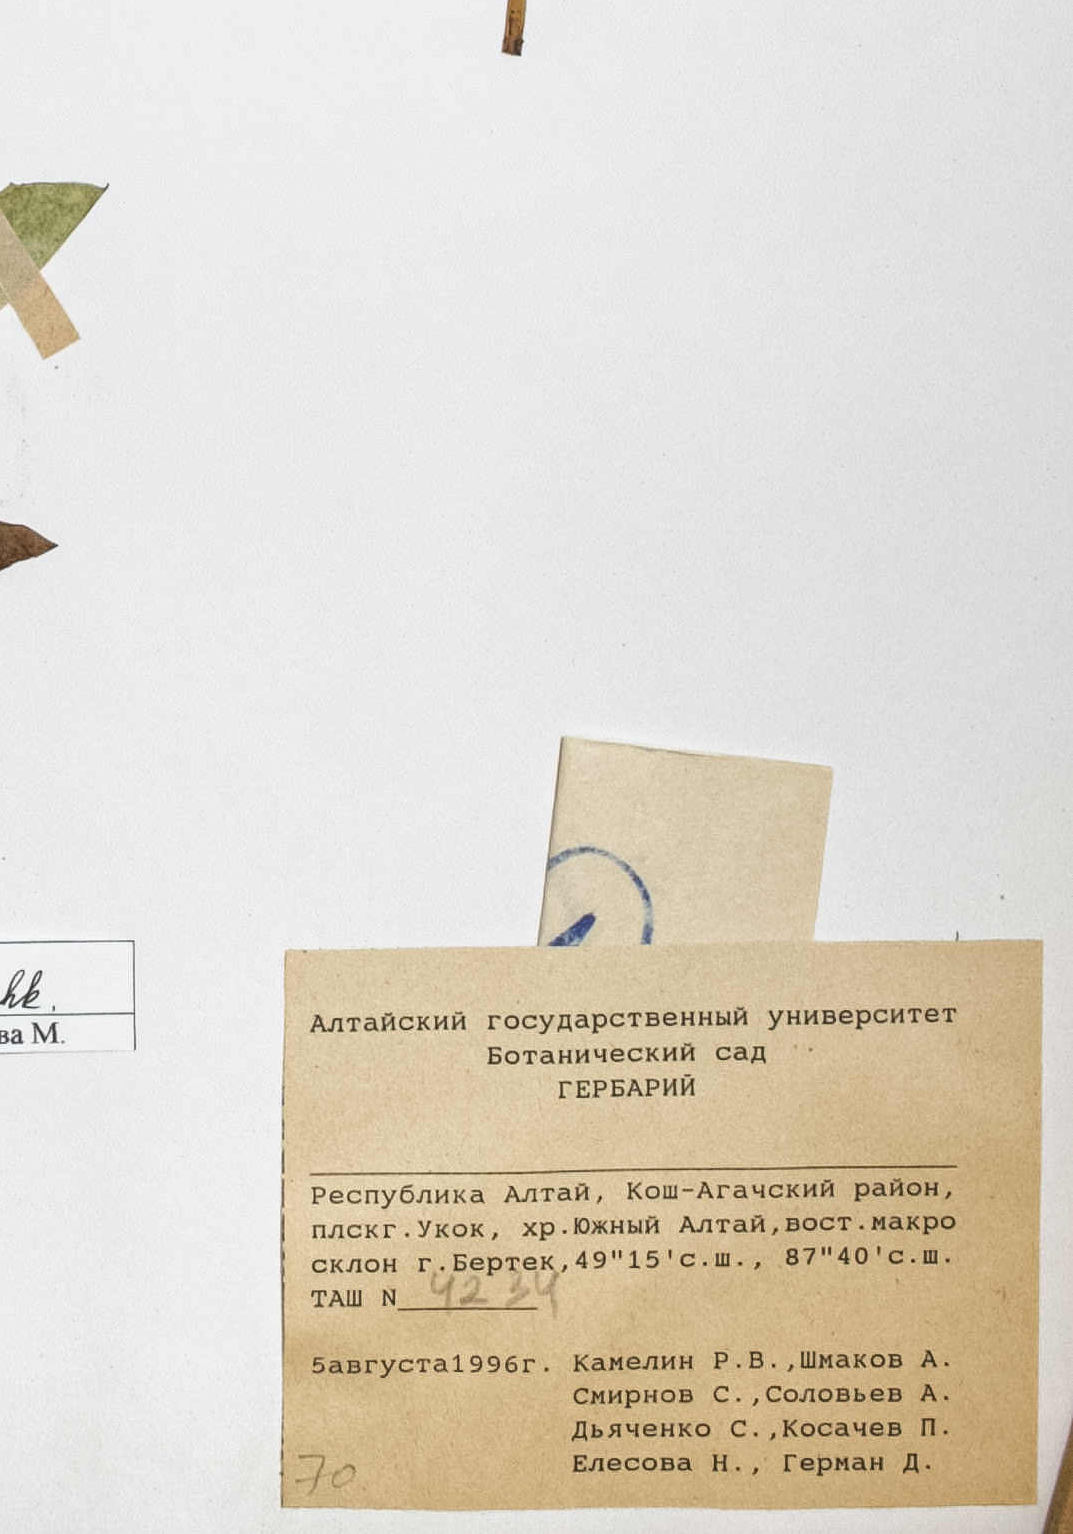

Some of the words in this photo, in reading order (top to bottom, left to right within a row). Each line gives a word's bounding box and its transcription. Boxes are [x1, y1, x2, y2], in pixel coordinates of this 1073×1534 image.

[310, 1011, 466, 1033] Алтайский
[488, 1006, 748, 1034] государственный
[767, 1008, 957, 1031] университет
[31, 1022, 66, 1046] М.
[487, 1042, 695, 1065] Ботанический
[716, 1046, 766, 1065] сад
[559, 1074, 695, 1099] ГЕРБАРИЙ
[311, 1184, 485, 1209] Республика
[504, 1183, 602, 1204] Алтай,
[627, 1179, 834, 1200] Кош-Агачский
[855, 1178, 951, 1202] район,
[312, 1258, 397, 1274] склон
[311, 1287, 363, 1308] ТАШ
[573, 1354, 693, 1372] Камелин
[921, 1350, 949, 1368] А.
[573, 1388, 693, 1408] Смирнов
[920, 1384, 948, 1402] А.
[571, 1421, 711, 1442] Дьяченко
[921, 1418, 948, 1436] П.
[573, 1455, 692, 1473] Елесова
[712, 1454, 758, 1475] Н.,
[783, 1454, 883, 1476] Герман
[903, 1453, 930, 1474] Д.
